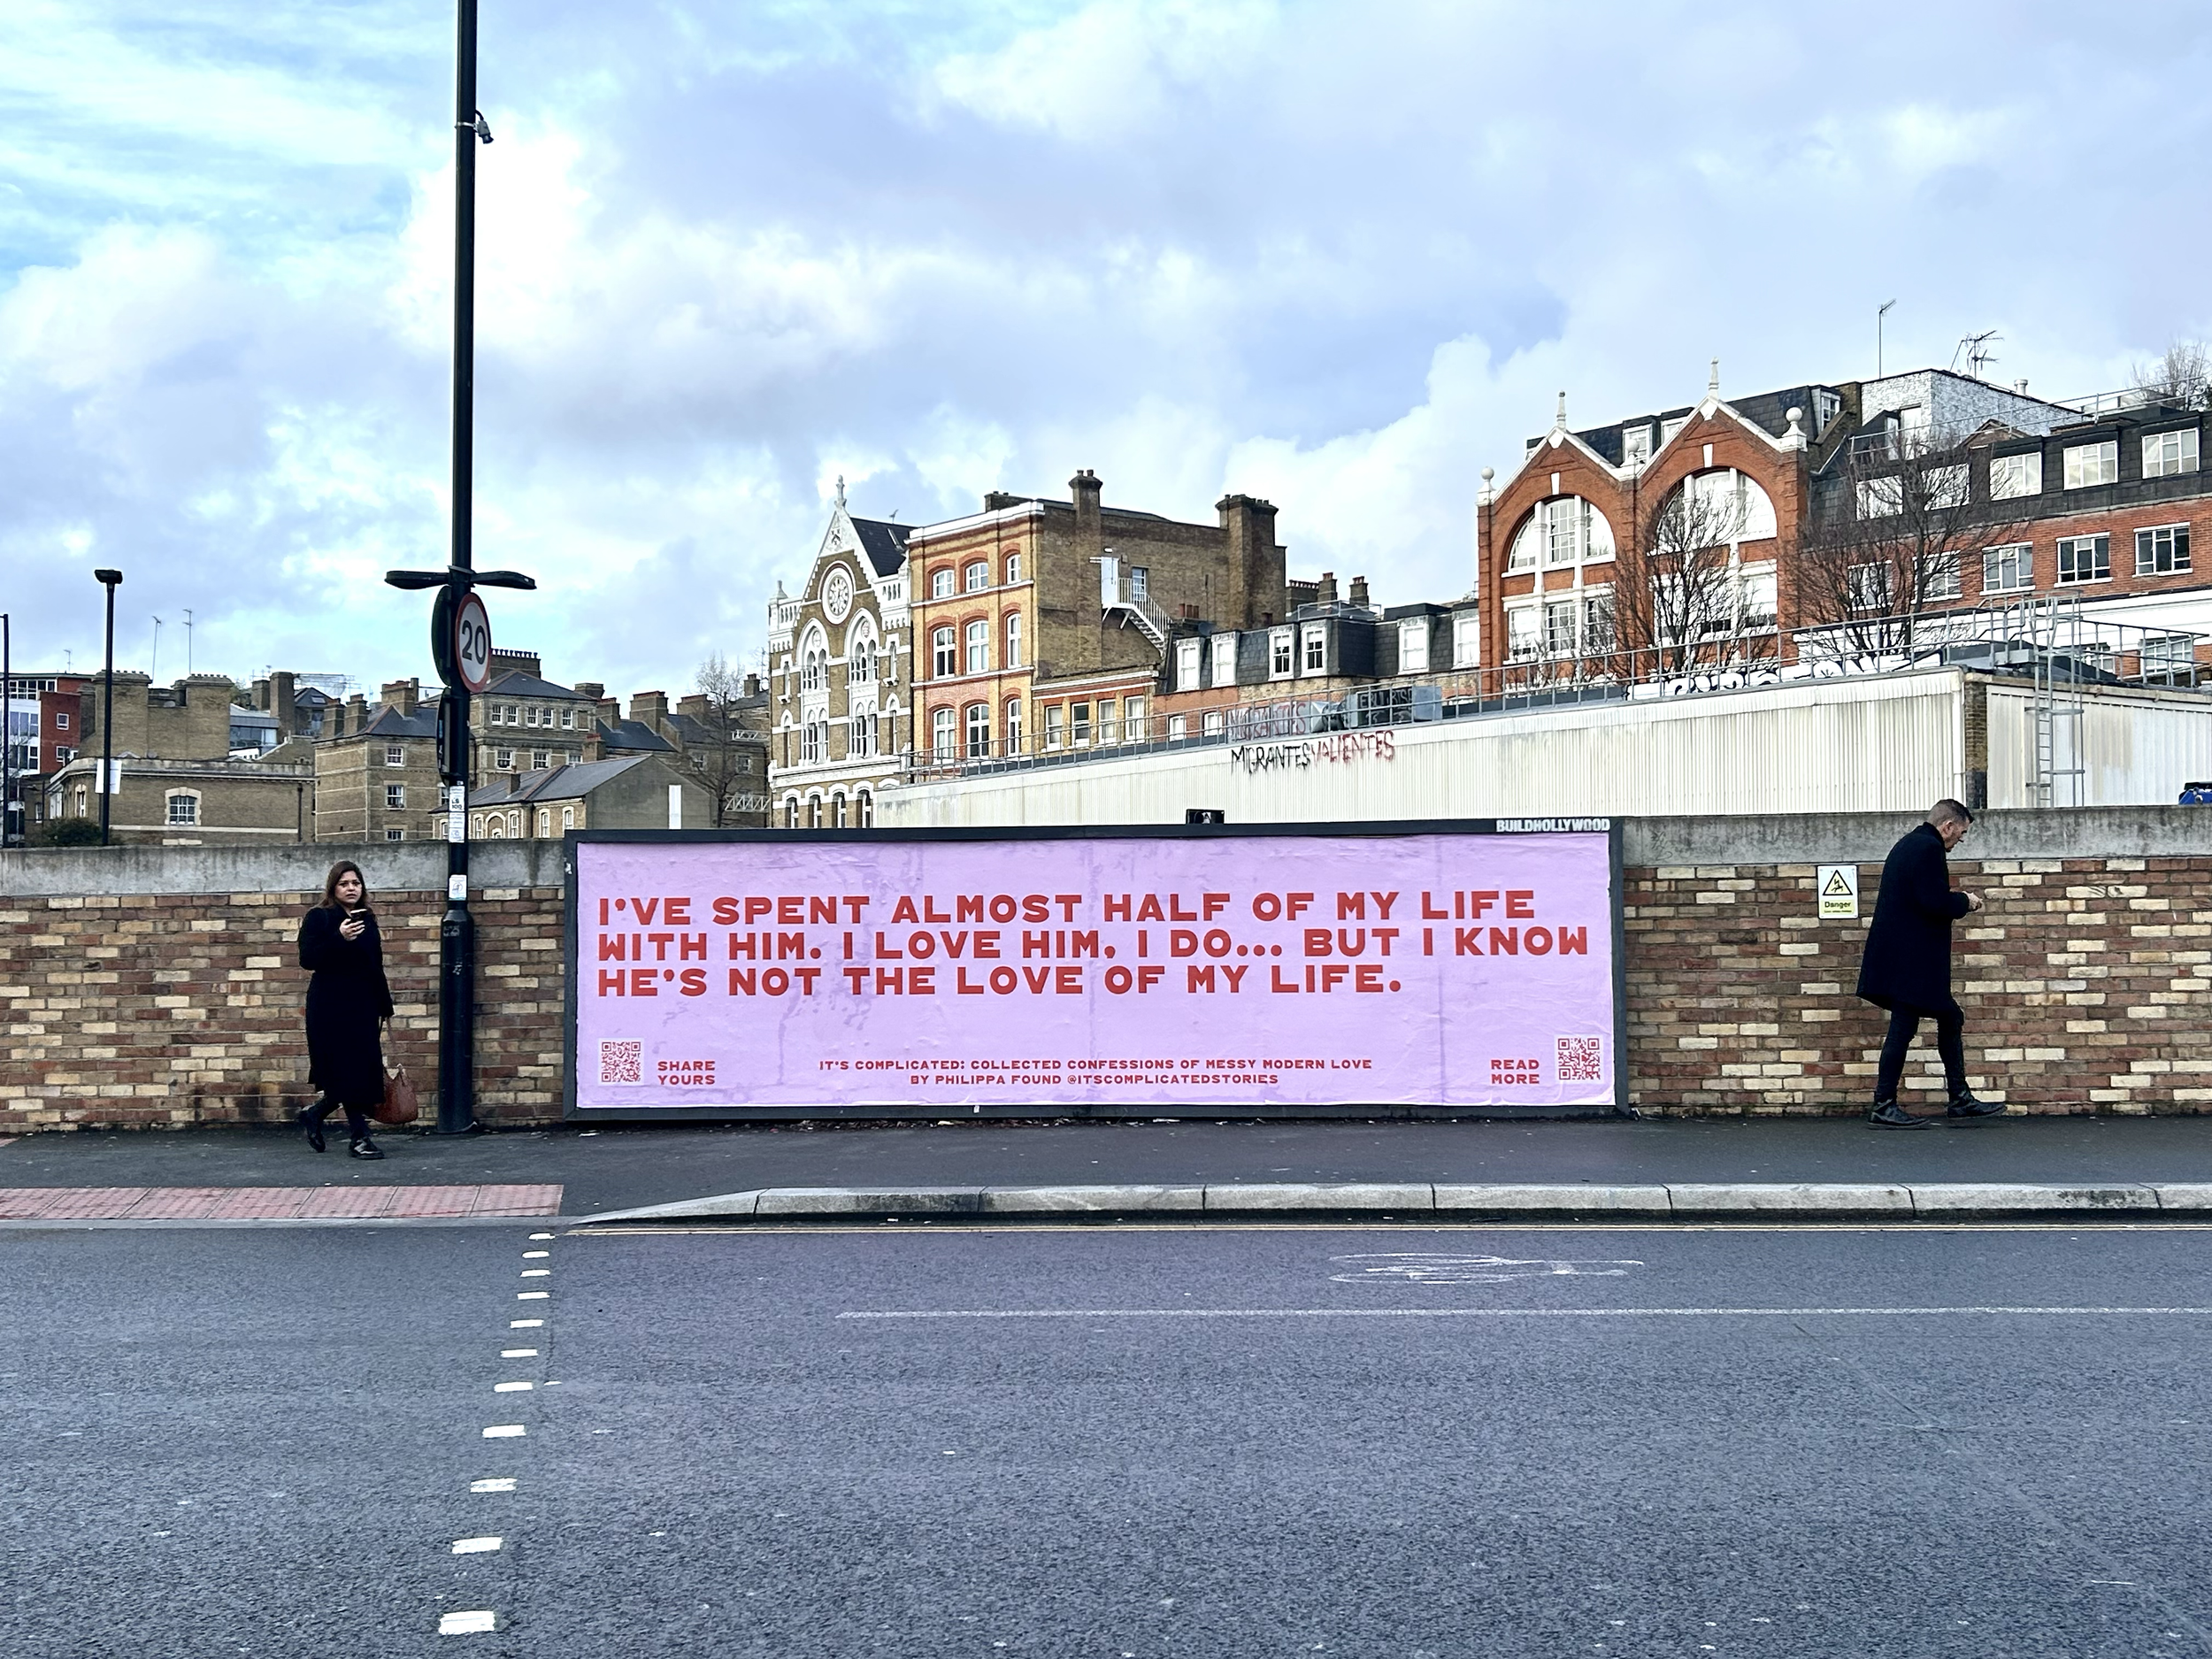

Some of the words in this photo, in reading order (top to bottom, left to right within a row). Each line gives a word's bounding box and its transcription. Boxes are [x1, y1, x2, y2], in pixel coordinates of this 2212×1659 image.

[462, 619, 486, 664] 20
[1231, 742, 1310, 774] MIGRANTES
[1496, 818, 1610, 832] BUILDHOLLYWOOD
[599, 897, 691, 926] I'VE
[712, 896, 870, 926] SPENT
[891, 895, 1082, 923] ALMOST
[1104, 894, 1231, 922] HALF
[1253, 893, 1314, 921] OF
[1337, 892, 1399, 920] MY
[1422, 890, 1535, 919] LIFE
[599, 933, 707, 961] WITH
[729, 933, 821, 960] HIM.
[843, 932, 853, 959] I
[876, 931, 1001, 959] LOVE
[1023, 930, 1116, 959] HIM,
[1138, 930, 1148, 957] I
[1171, 929, 1282, 957] DO...
[1304, 928, 1400, 956] BUT
[1424, 928, 1432, 956] I
[1455, 926, 1587, 956] KNOW
[599, 968, 707, 996] HE'S
[729, 968, 821, 996] NOT
[843, 967, 935, 995] THE
[957, 966, 1082, 995] LOVE
[1104, 965, 1165, 995] OF
[1187, 964, 1248, 993] MY
[1271, 964, 1402, 993] LIFE.
[657, 1060, 715, 1071] SHARE
[819, 1060, 849, 1070] IT'S
[855, 1060, 965, 1070] COMPLICATED:
[971, 1060, 1062, 1070] COLLECTED
[1067, 1060, 1174, 1070] CONFESSIONS
[1179, 1059, 1199, 1070] OF
[1205, 1059, 1256, 1069] MESSY
[1263, 1059, 1325, 1070] MODERN
[1331, 1059, 1372, 1070] LOVE
[1491, 1059, 1540, 1070] READ
[657, 1074, 715, 1086] YOURS
[910, 1075, 929, 1085] BY
[935, 1075, 1005, 1085] PHILIPPA
[1010, 1074, 1062, 1085] FOUND
[1067, 1074, 1279, 1085] @ITSCOMPLICATEDSTORIES
[1491, 1073, 1540, 1085] MORE
